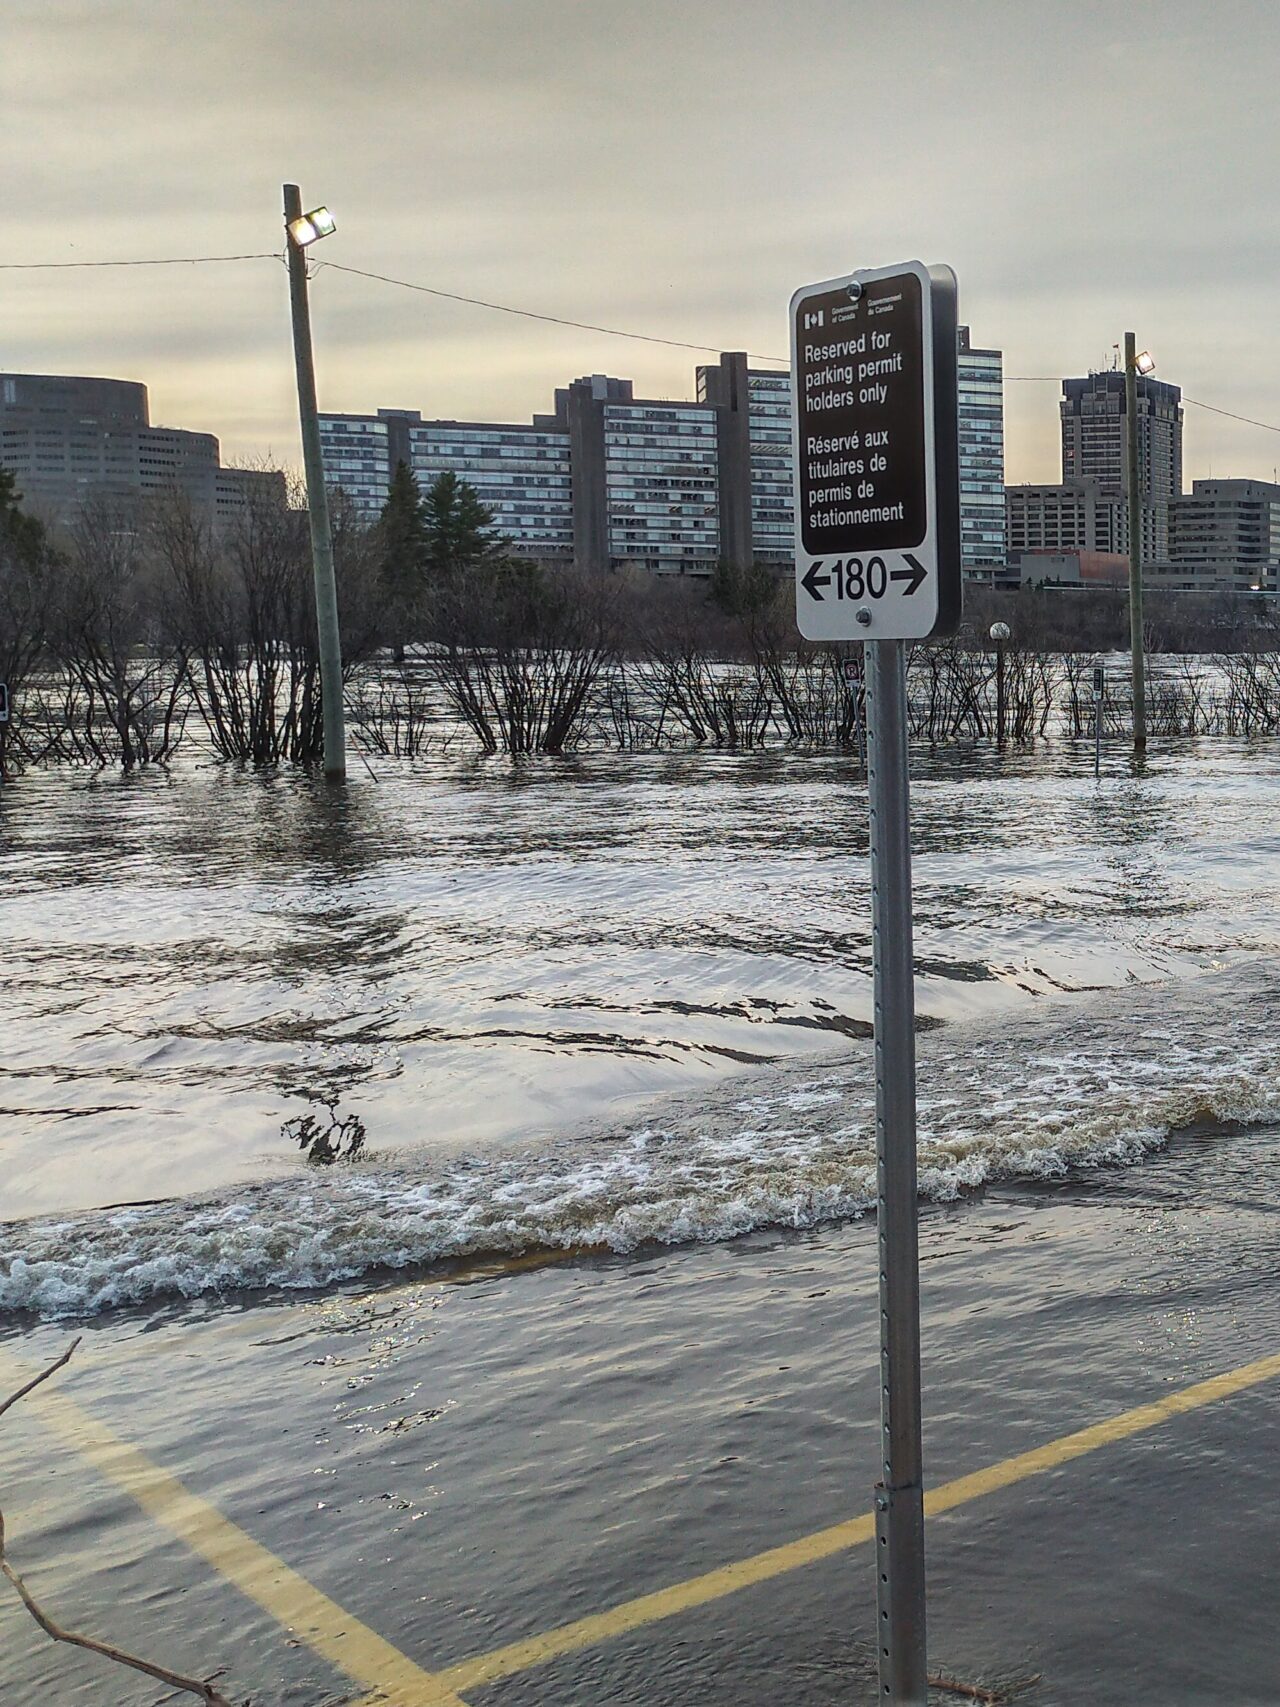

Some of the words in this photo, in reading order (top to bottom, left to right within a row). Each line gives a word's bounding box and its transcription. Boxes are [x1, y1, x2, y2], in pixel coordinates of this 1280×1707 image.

[805, 333, 866, 363] Reserved
[871, 331, 891, 350] for
[805, 363, 853, 391] parking
[858, 352, 902, 382] permit
[806, 390, 854, 413] holders
[859, 382, 888, 404] only
[807, 430, 859, 455] Réservé
[865, 430, 889, 448] aux
[808, 458, 864, 479] titulaires
[870, 453, 887, 472] de
[809, 483, 852, 508] permis
[857, 480, 875, 499] de
[809, 501, 904, 529] stationnement
[831, 556, 887, 600] 180
